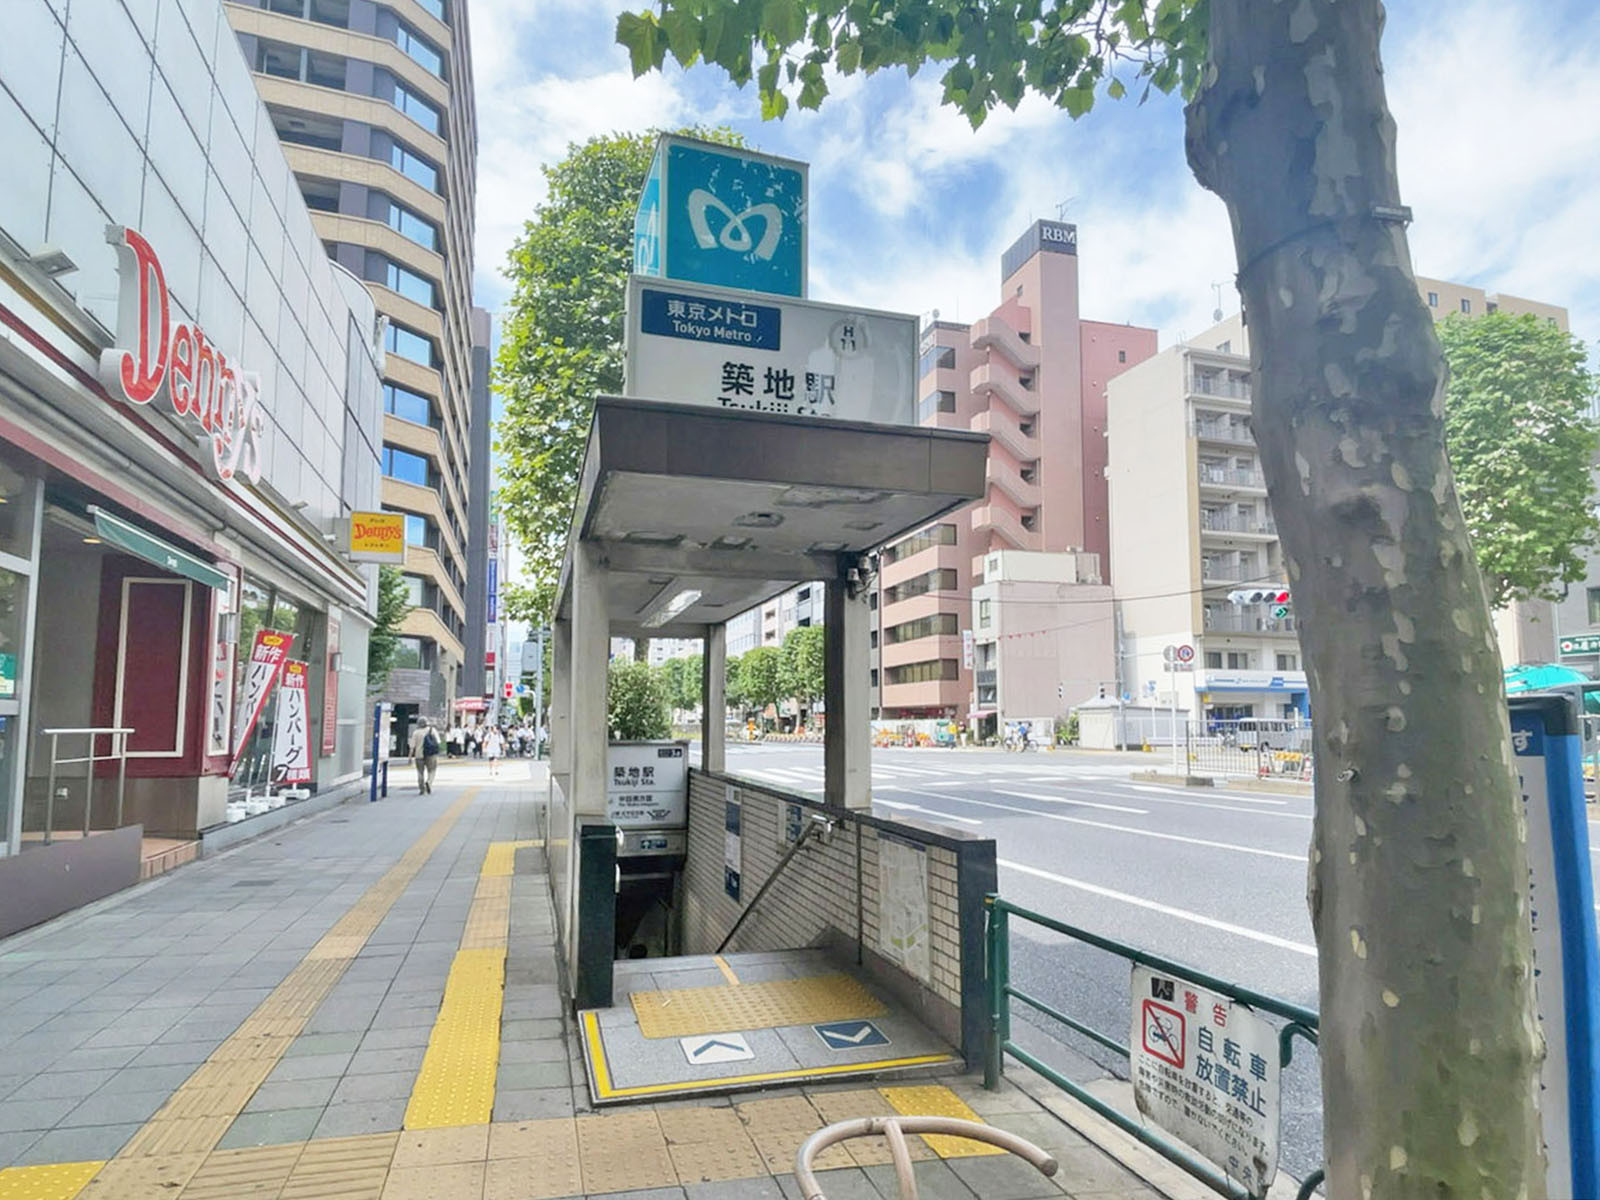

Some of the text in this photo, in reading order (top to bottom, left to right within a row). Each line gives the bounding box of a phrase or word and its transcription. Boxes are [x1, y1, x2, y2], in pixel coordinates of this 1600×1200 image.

[1042, 226, 1076, 244] RBM
[667, 300, 757, 327] 東京メトロ
[672, 319, 752, 342] Tokyo Metro
[843, 325, 854, 337] H
[721, 362, 835, 405] 築地駅
[285, 690, 303, 764] ハンバーグ
[614, 766, 655, 778] 築地駅
[1184, 991, 1227, 1027] 警告
[1198, 1026, 1267, 1082] 自転車
[1195, 1053, 1267, 1118] 放置禁止
